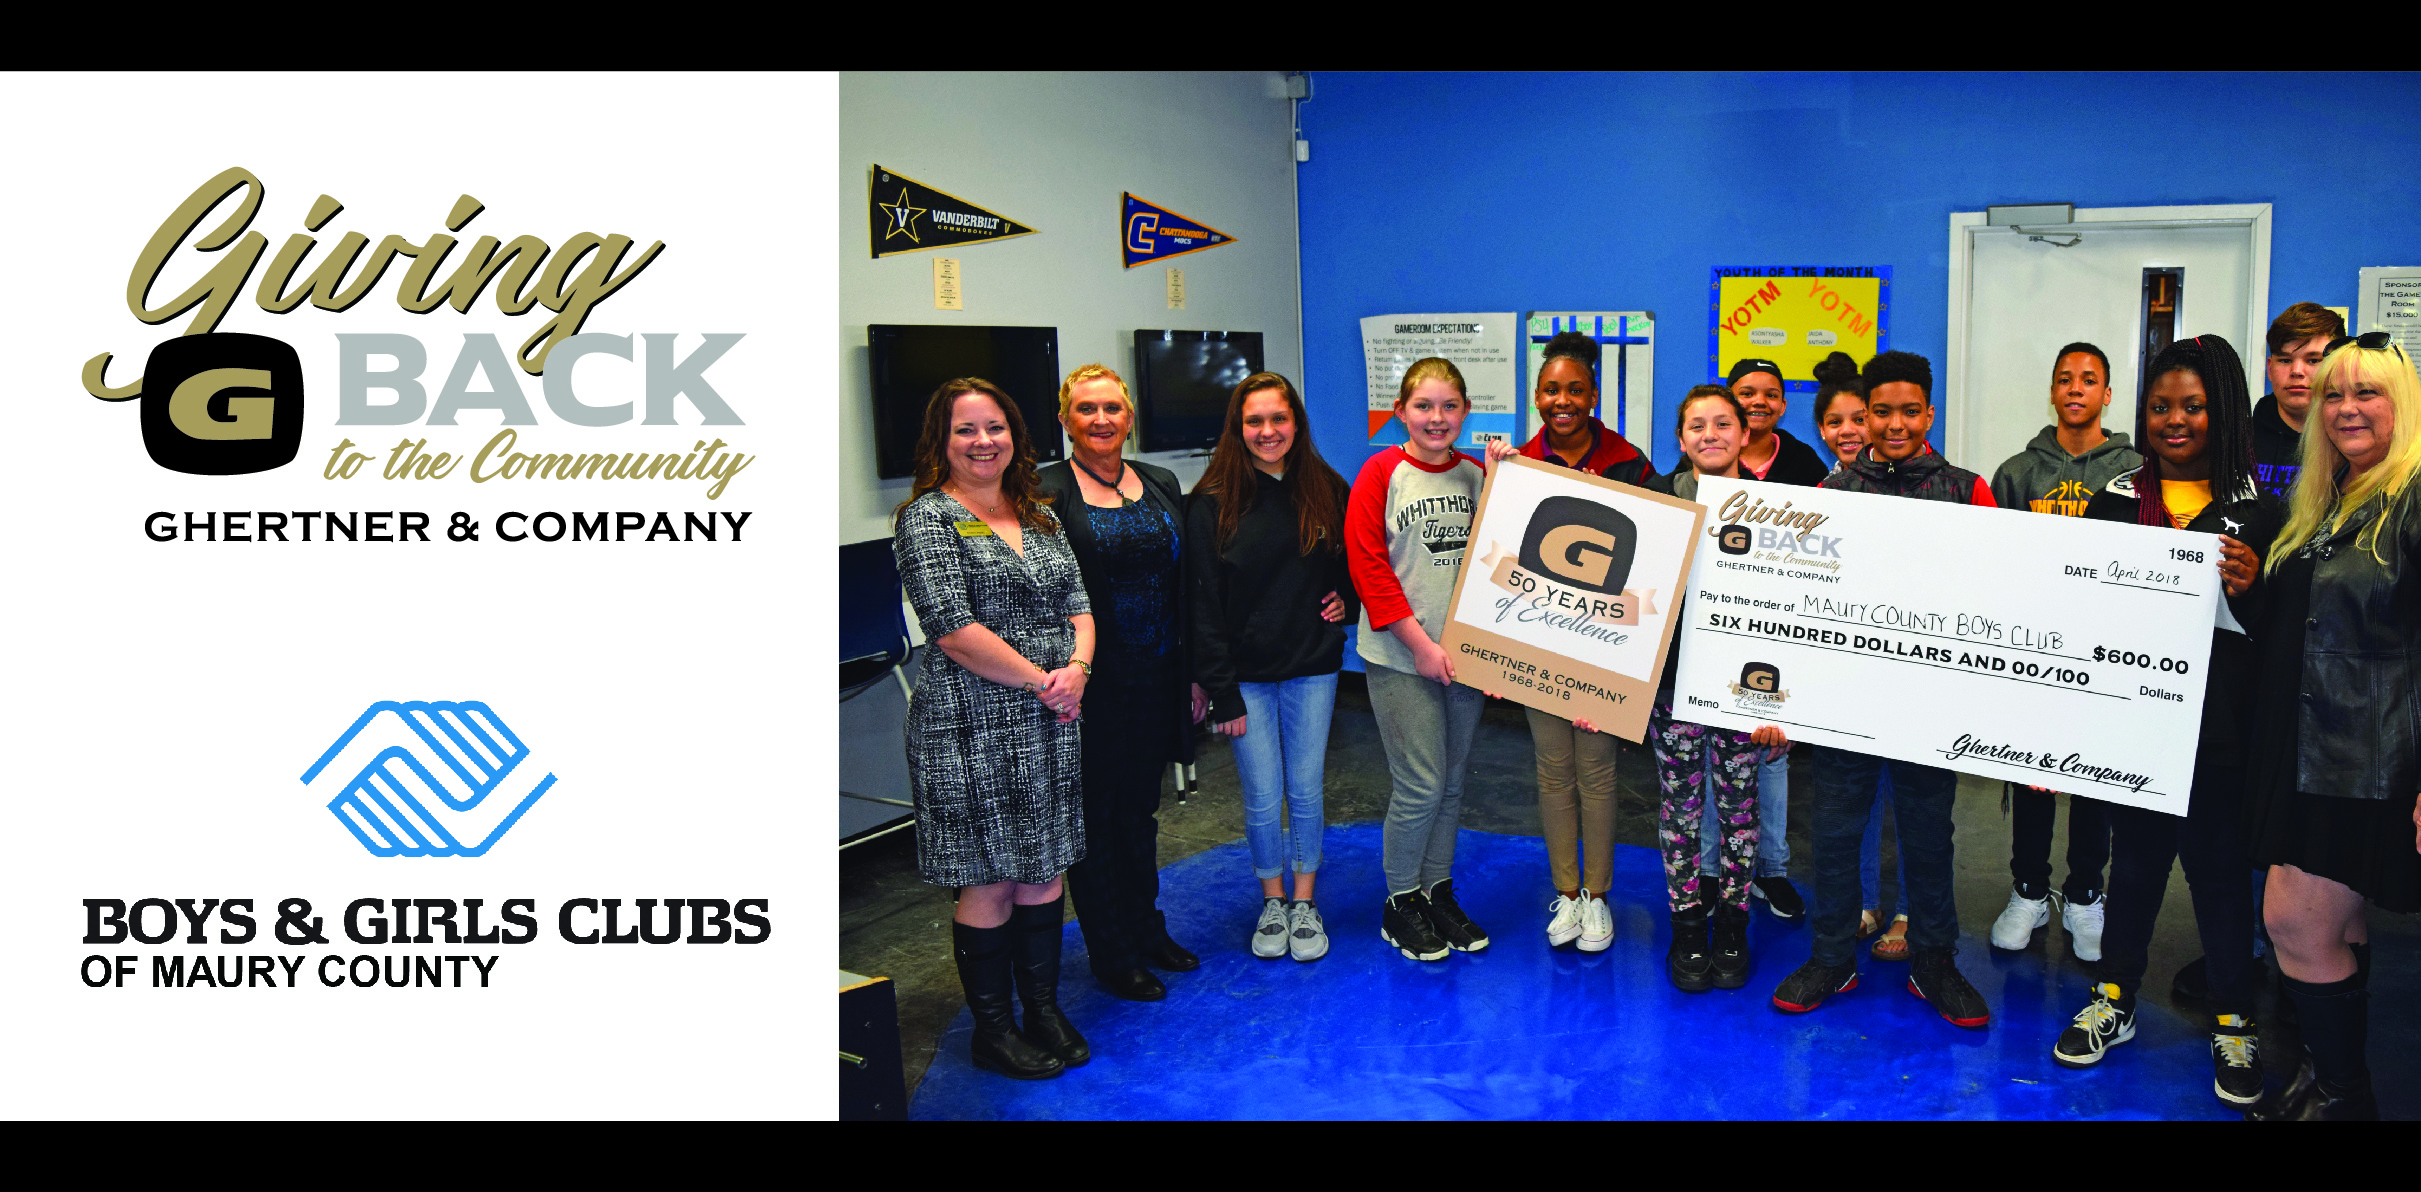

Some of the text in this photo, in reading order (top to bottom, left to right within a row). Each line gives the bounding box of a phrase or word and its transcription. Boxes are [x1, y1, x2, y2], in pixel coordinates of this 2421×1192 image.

[895, 207, 910, 228] V
[932, 209, 1000, 230] VANDERBILT
[1127, 212, 1160, 254] C
[1714, 266, 1874, 278] YOUTH OF THE MONTH
[1720, 279, 1782, 336] YOTM
[1808, 277, 1874, 339] YOTM
[1394, 324, 1431, 334] GAMEROOM
[1531, 317, 1550, 334] PS4
[1383, 338, 1405, 346] fighting
[1707, 489, 1830, 542] Giving
[1723, 527, 1844, 559] G BACK
[1539, 523, 1617, 587] G
[1753, 550, 1843, 573] to the Community
[2168, 547, 2205, 564] 1968
[1716, 560, 1841, 584] GHERTNER & COMPANY
[2064, 564, 2098, 580] DATE
[2145, 569, 2180, 586] 2018
[1508, 569, 1626, 619] 50 YEARS
[1700, 590, 1795, 612] Pay to the order of
[1495, 592, 1629, 646] of Excellence
[1871, 604, 1948, 633] COUNTY
[1956, 612, 2002, 640] BOYS
[2011, 625, 2064, 651] CLUB
[1709, 613, 2090, 686] SIX HUNDRED DOLLARS AND 00/100
[2092, 645, 2189, 675] $600.00
[1460, 643, 1628, 705] GHERTNER & COMPANY
[1502, 669, 1571, 701] 1968-2018
[1746, 670, 1773, 691] G
[1688, 695, 1720, 709] Memo
[1738, 688, 1781, 701] 50 YEARS
[2139, 685, 2184, 702] Dollars
[1945, 733, 2154, 794] Ghertner & Company
